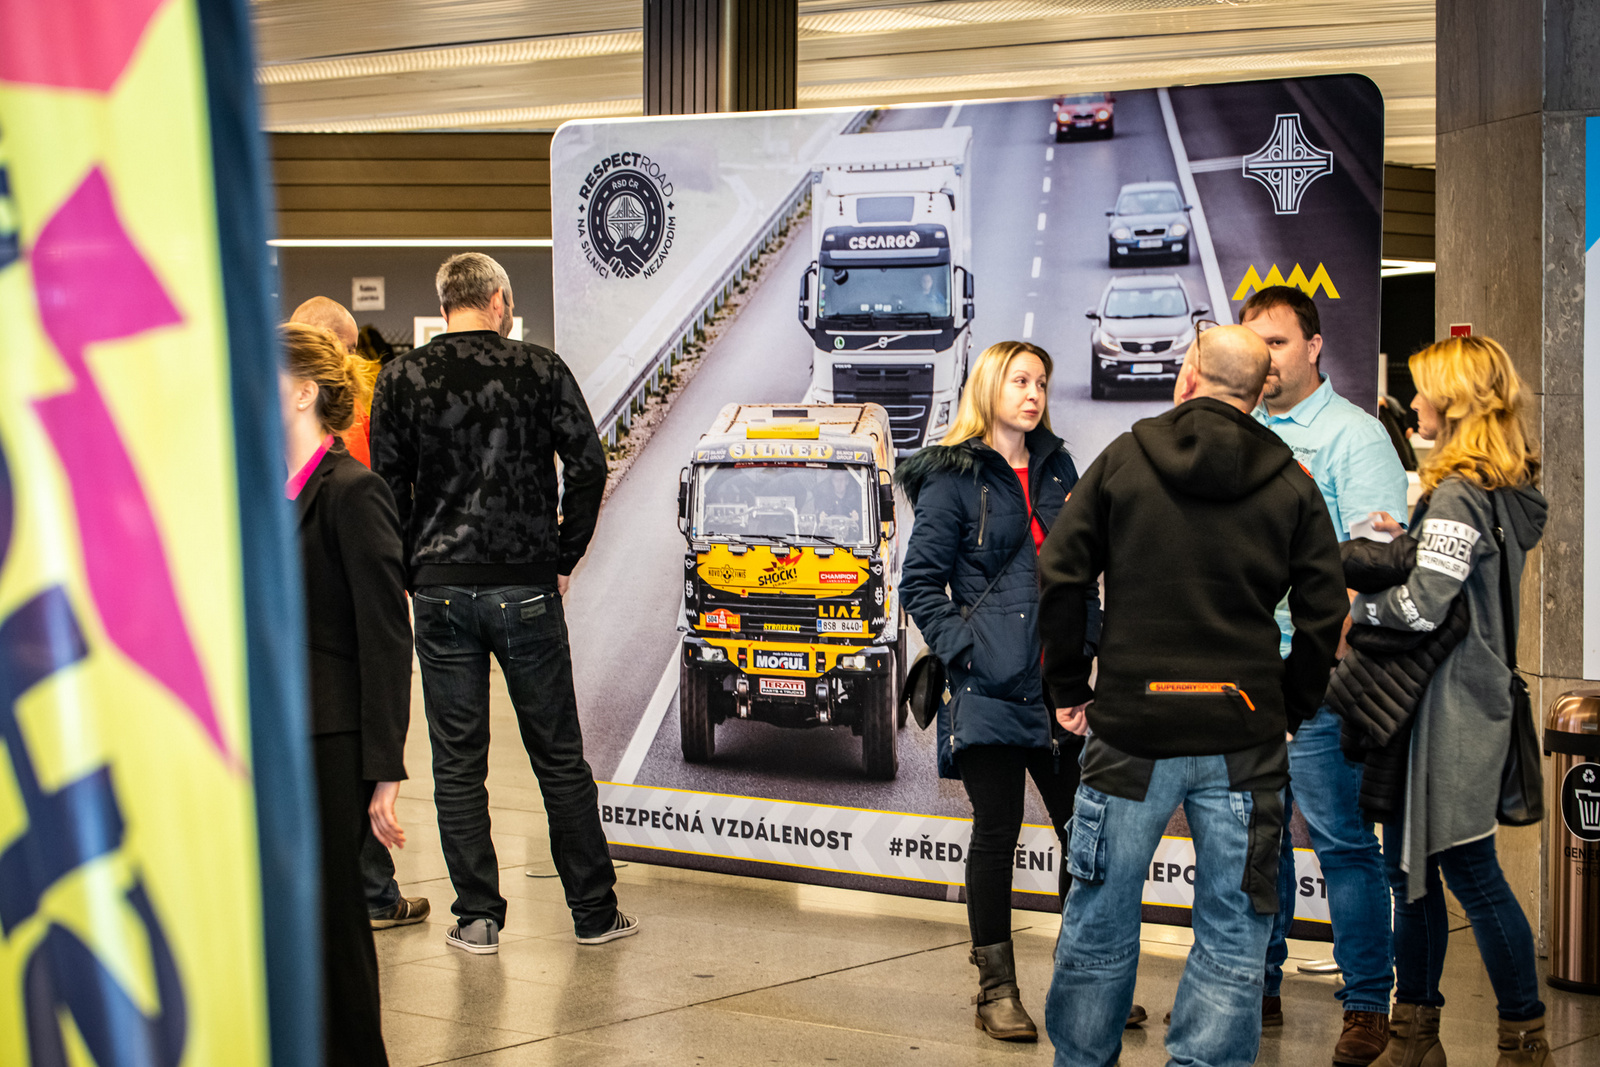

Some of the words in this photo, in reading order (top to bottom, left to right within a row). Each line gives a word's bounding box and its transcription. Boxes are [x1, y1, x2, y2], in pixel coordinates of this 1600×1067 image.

[577, 219, 586, 238] NA
[643, 216, 676, 279] NEZÁVODÍM
[849, 234, 917, 249] CSCARGO
[581, 241, 609, 279] SILNICI
[733, 443, 828, 458] SILMET
[758, 568, 798, 586] SHOCK!
[841, 622, 859, 631] 8440
[756, 655, 806, 670] MOGUL
[598, 804, 704, 833] BEZPEČNÁ
[712, 816, 853, 851] VZDÁLENOST
